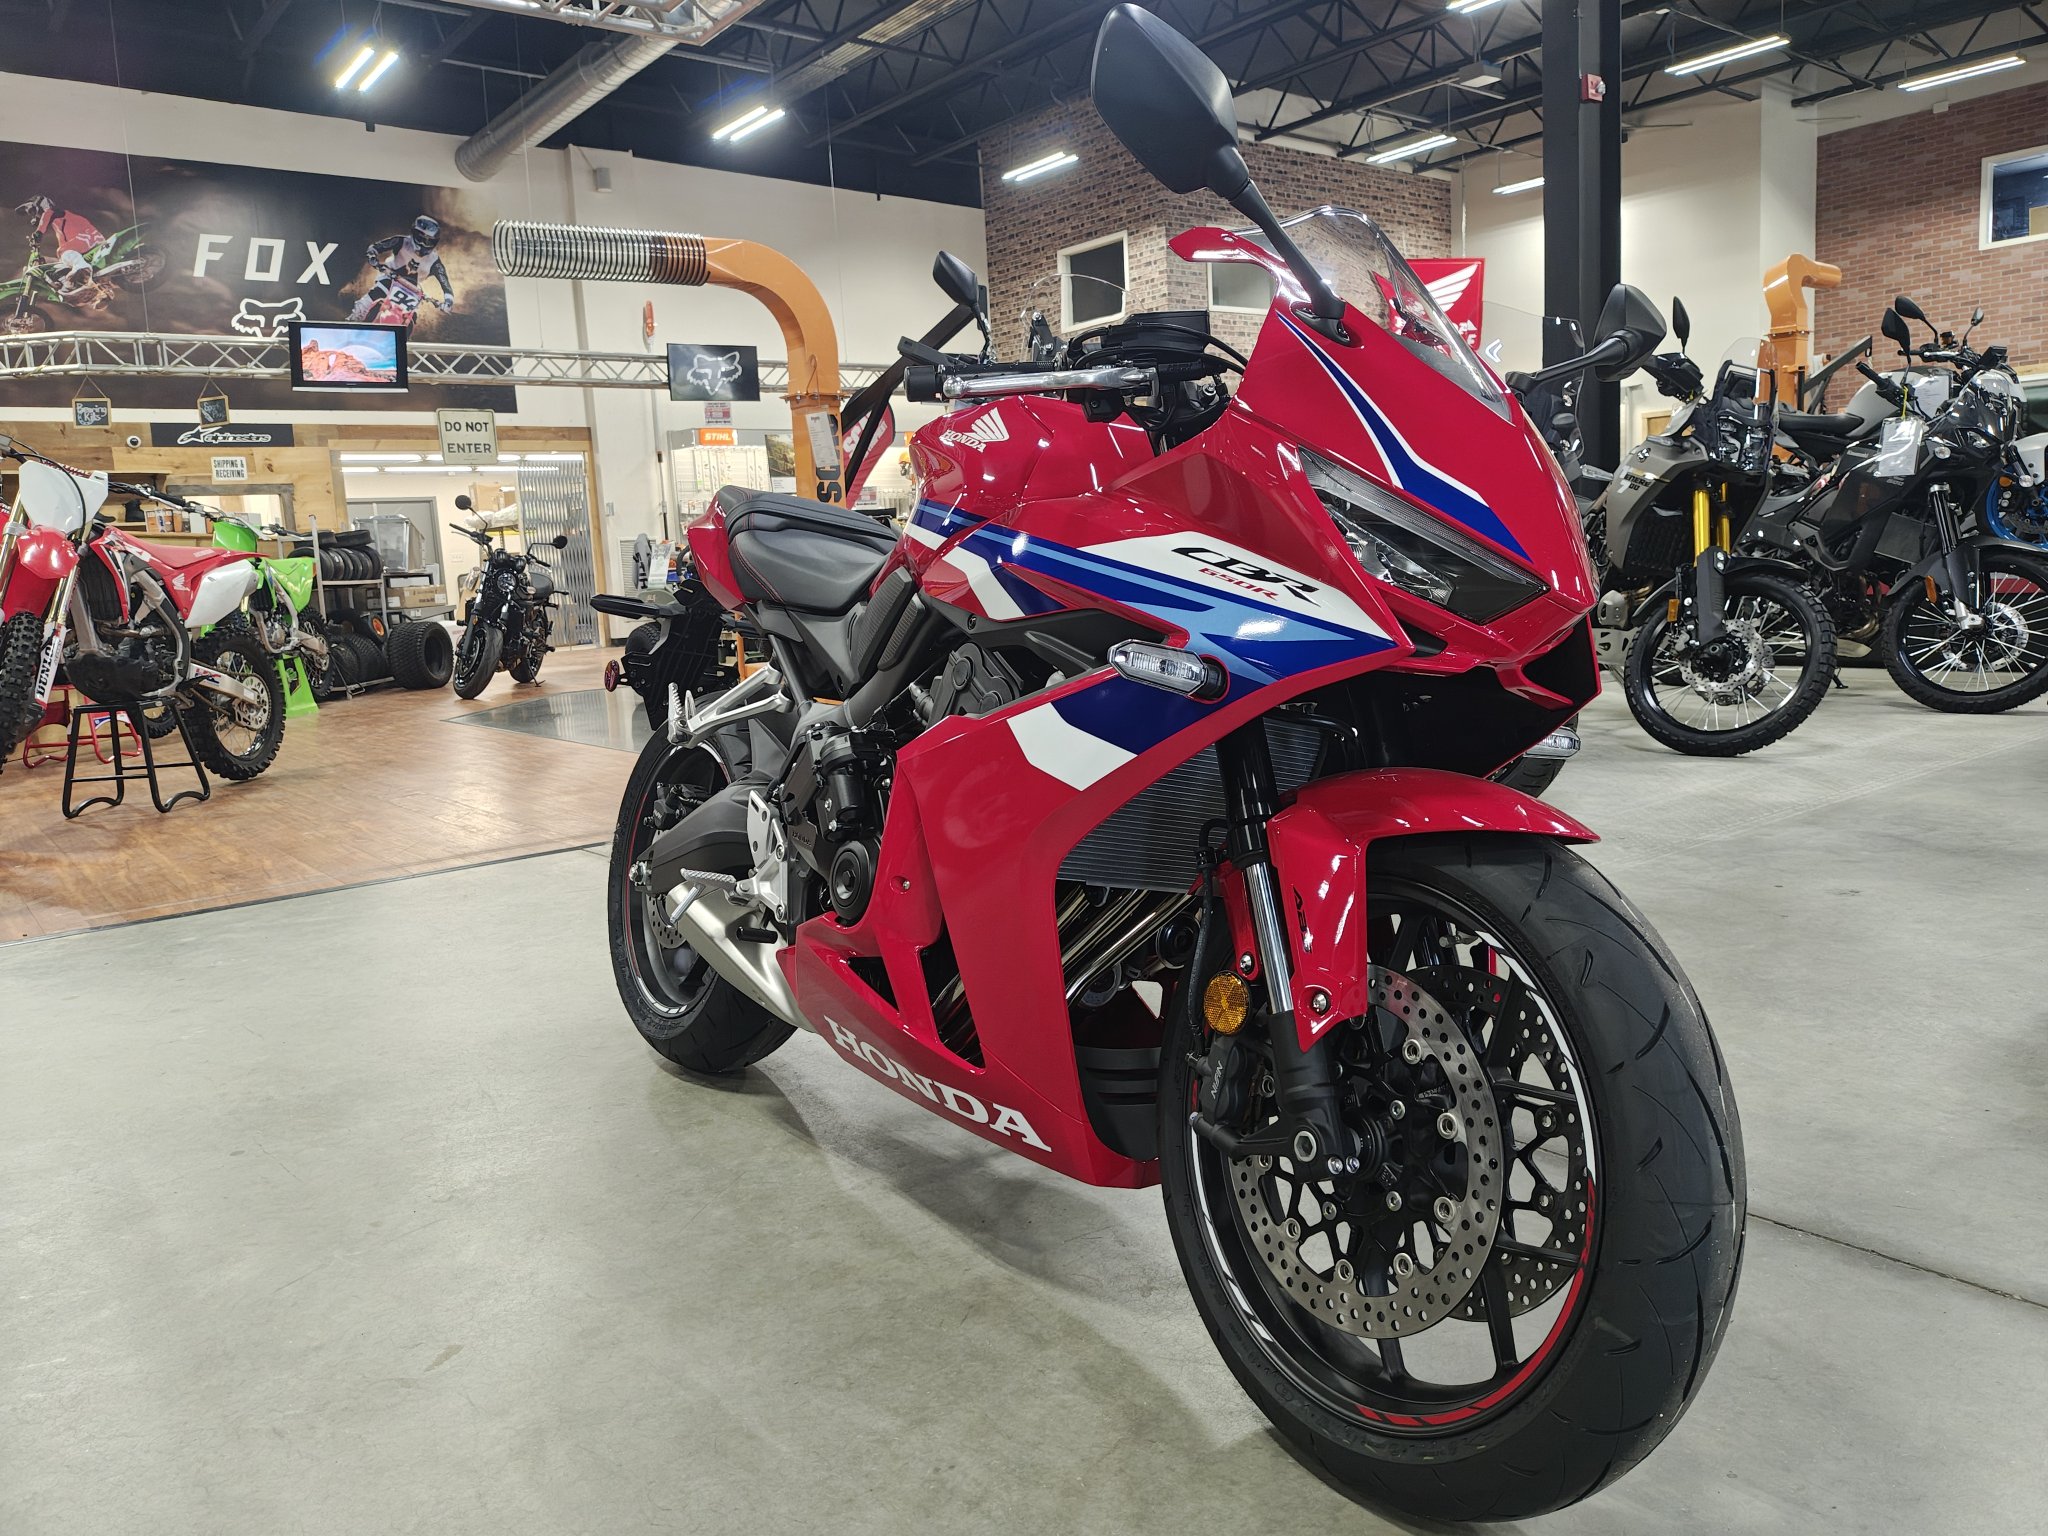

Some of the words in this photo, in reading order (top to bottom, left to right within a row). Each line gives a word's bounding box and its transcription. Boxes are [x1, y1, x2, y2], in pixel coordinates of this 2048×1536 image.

[193, 233, 339, 286] FOX
[444, 421, 462, 432] DO
[465, 421, 489, 432] NOT
[704, 432, 731, 441] STIHL
[939, 429, 987, 453] HONDA
[447, 443, 492, 454] ENTER
[213, 459, 239, 469] SHIPPING
[215, 469, 245, 478] RECEIVING
[1171, 547, 1321, 608] CBR
[1198, 567, 1279, 601] 650R
[824, 1014, 1053, 1153] HONDA
